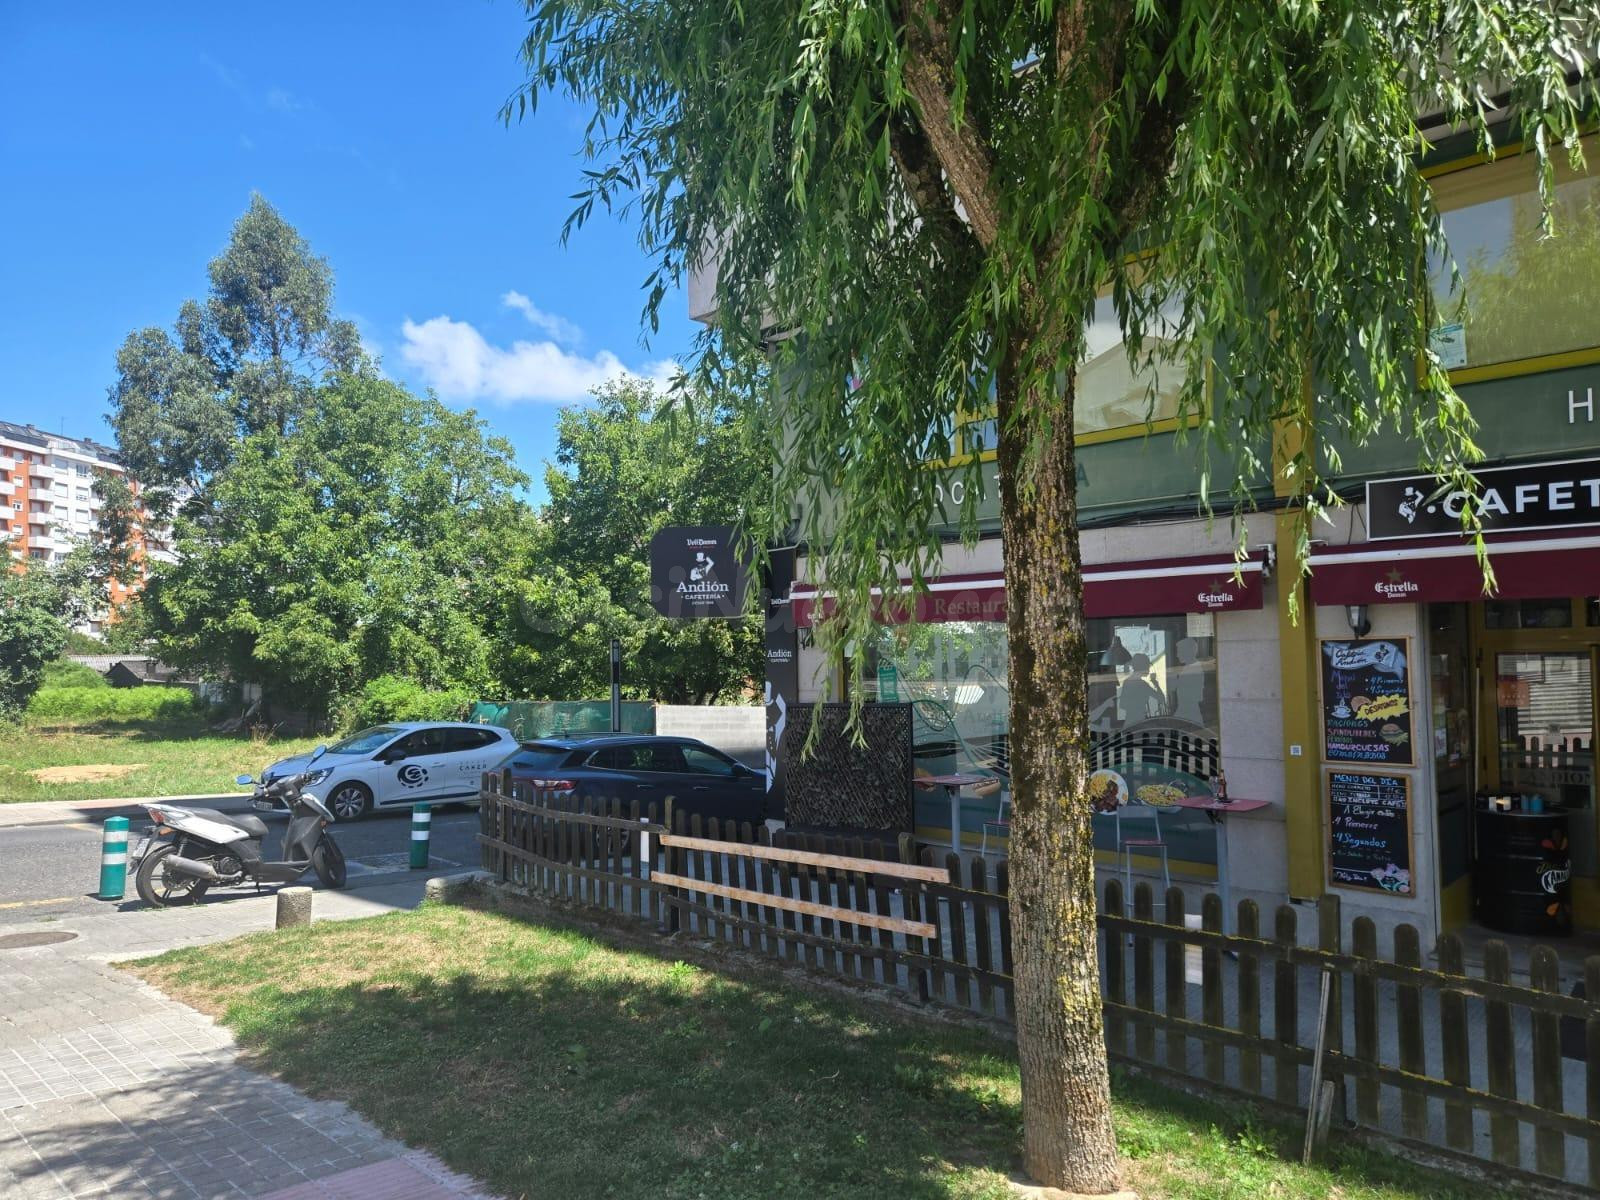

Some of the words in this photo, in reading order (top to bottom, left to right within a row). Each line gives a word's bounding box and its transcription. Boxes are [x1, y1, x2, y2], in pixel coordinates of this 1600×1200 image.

[1442, 478, 1600, 519] CAFET
[676, 581, 729, 593] Andión
[1375, 580, 1418, 593] Estrella
[1198, 591, 1233, 602] Estrella
[767, 649, 792, 658] Andión
